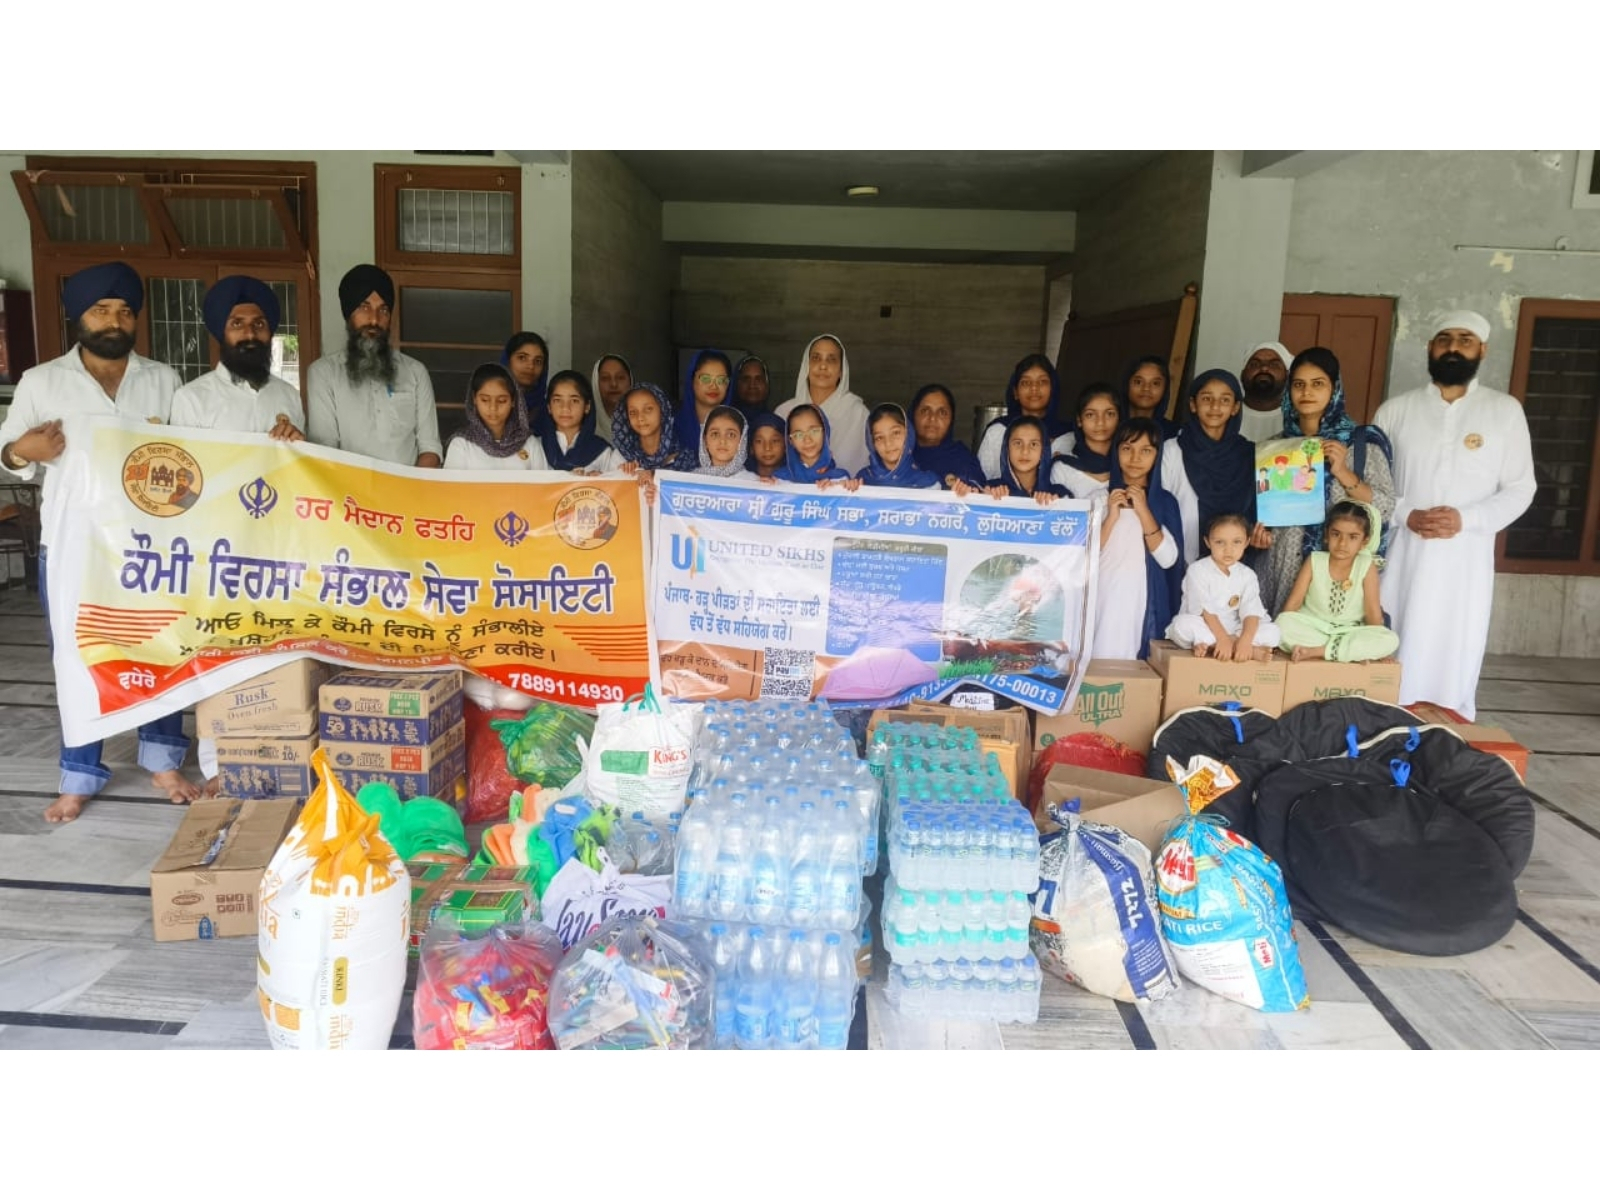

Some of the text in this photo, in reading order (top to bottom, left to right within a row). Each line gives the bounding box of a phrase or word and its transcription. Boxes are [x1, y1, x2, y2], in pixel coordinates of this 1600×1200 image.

[295, 496, 476, 542] ਹਰ ਮੈਦਾਨ ਫਤਹਿ
[672, 491, 742, 514] ਗੁਰਦੁਆਰਾ
[770, 502, 796, 525] ਗੁਰੂ
[802, 499, 831, 520] ਸਿੰਘ
[708, 539, 772, 558] UNITED
[777, 545, 826, 562] SIKHS
[120, 529, 615, 615] ਕੌਮੀ ਵਿਰਸਾ ਸੰਭਾਲ ਸੇਵਾ ਸੋਸਾਇਟੀ
[304, 613, 324, 629] ਕੇ
[332, 614, 374, 636] ਕੌਮੀ
[384, 619, 437, 642] ਵਿਰਸੇ
[235, 687, 269, 706] Rusk
[508, 672, 624, 701] 7889114930
[1199, 683, 1252, 700] MAXO
[1080, 708, 1122, 722] ULTRA
[1185, 920, 1224, 936] RICE
